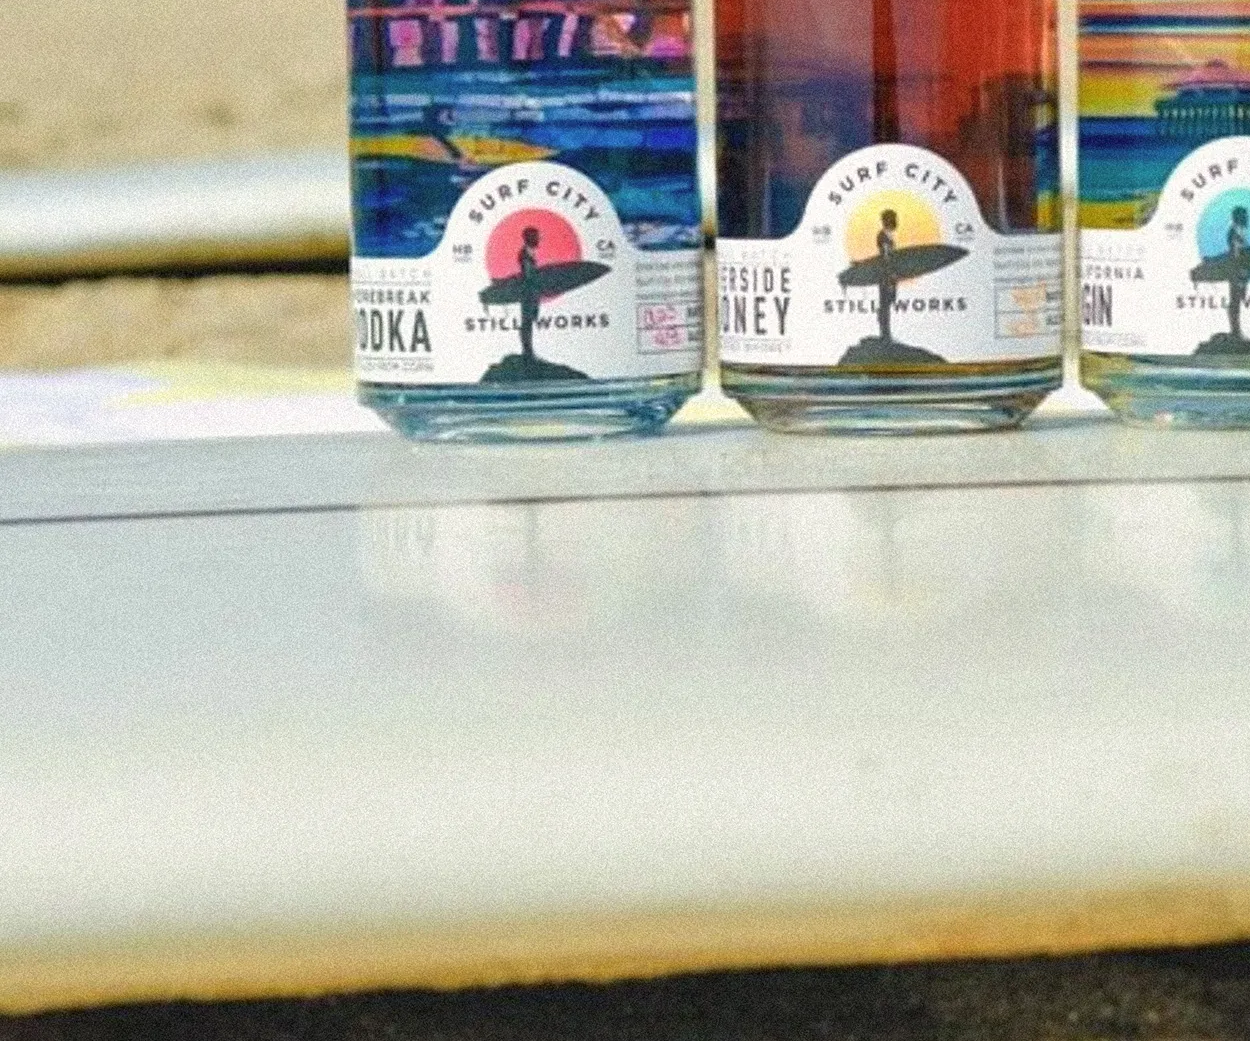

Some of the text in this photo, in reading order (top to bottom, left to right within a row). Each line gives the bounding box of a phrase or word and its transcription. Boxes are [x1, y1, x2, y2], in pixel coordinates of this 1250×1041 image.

[829, 160, 958, 205] SURF CITY
[1181, 159, 1240, 201] SURF
[469, 179, 601, 225] SURF CITY
[956, 223, 974, 235] CA
[596, 239, 616, 251] CA
[824, 297, 968, 314] STILL WORKS
[1082, 284, 1113, 328] GIN
[1176, 295, 1231, 309] STILL
[465, 313, 610, 332] STILL WORKS
